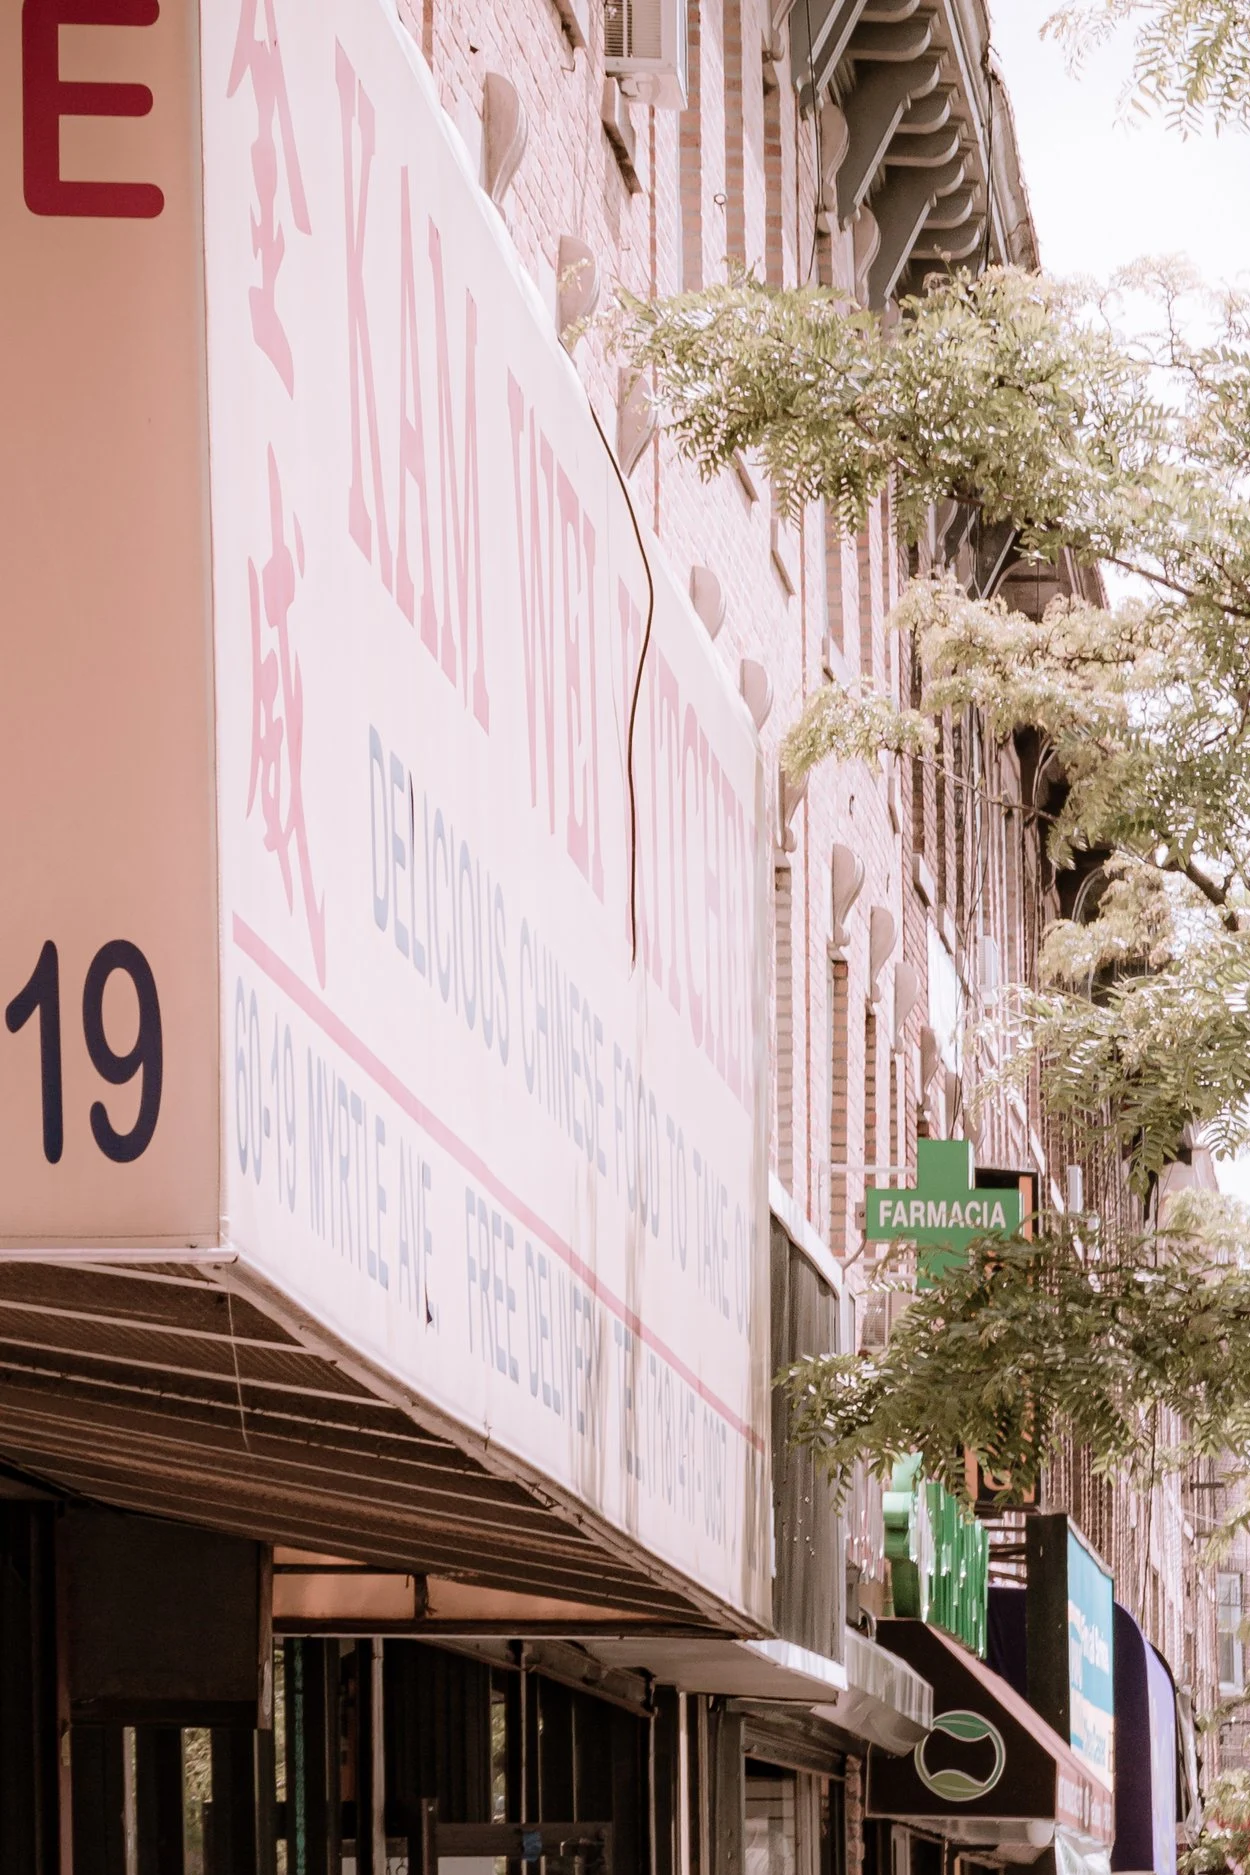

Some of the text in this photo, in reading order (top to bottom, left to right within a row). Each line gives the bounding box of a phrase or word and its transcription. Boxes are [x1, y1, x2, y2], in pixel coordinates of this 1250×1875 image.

[335, 35, 757, 1122] KAM WEI KITCHEN
[5, 939, 164, 1164] 19
[234, 975, 297, 1214] 60-19
[307, 1045, 389, 1292] MYRTLE
[465, 1185, 520, 1385] FREE
[525, 1239, 605, 1453] DELIVERY
[369, 723, 510, 1067] DELICIOUS
[519, 917, 607, 1178] CHINESE
[613, 1041, 660, 1240] FOOD
[666, 1113, 688, 1273] TO
[693, 1147, 730, 1321] TAKE
[879, 1199, 1007, 1229] FARMACIA
